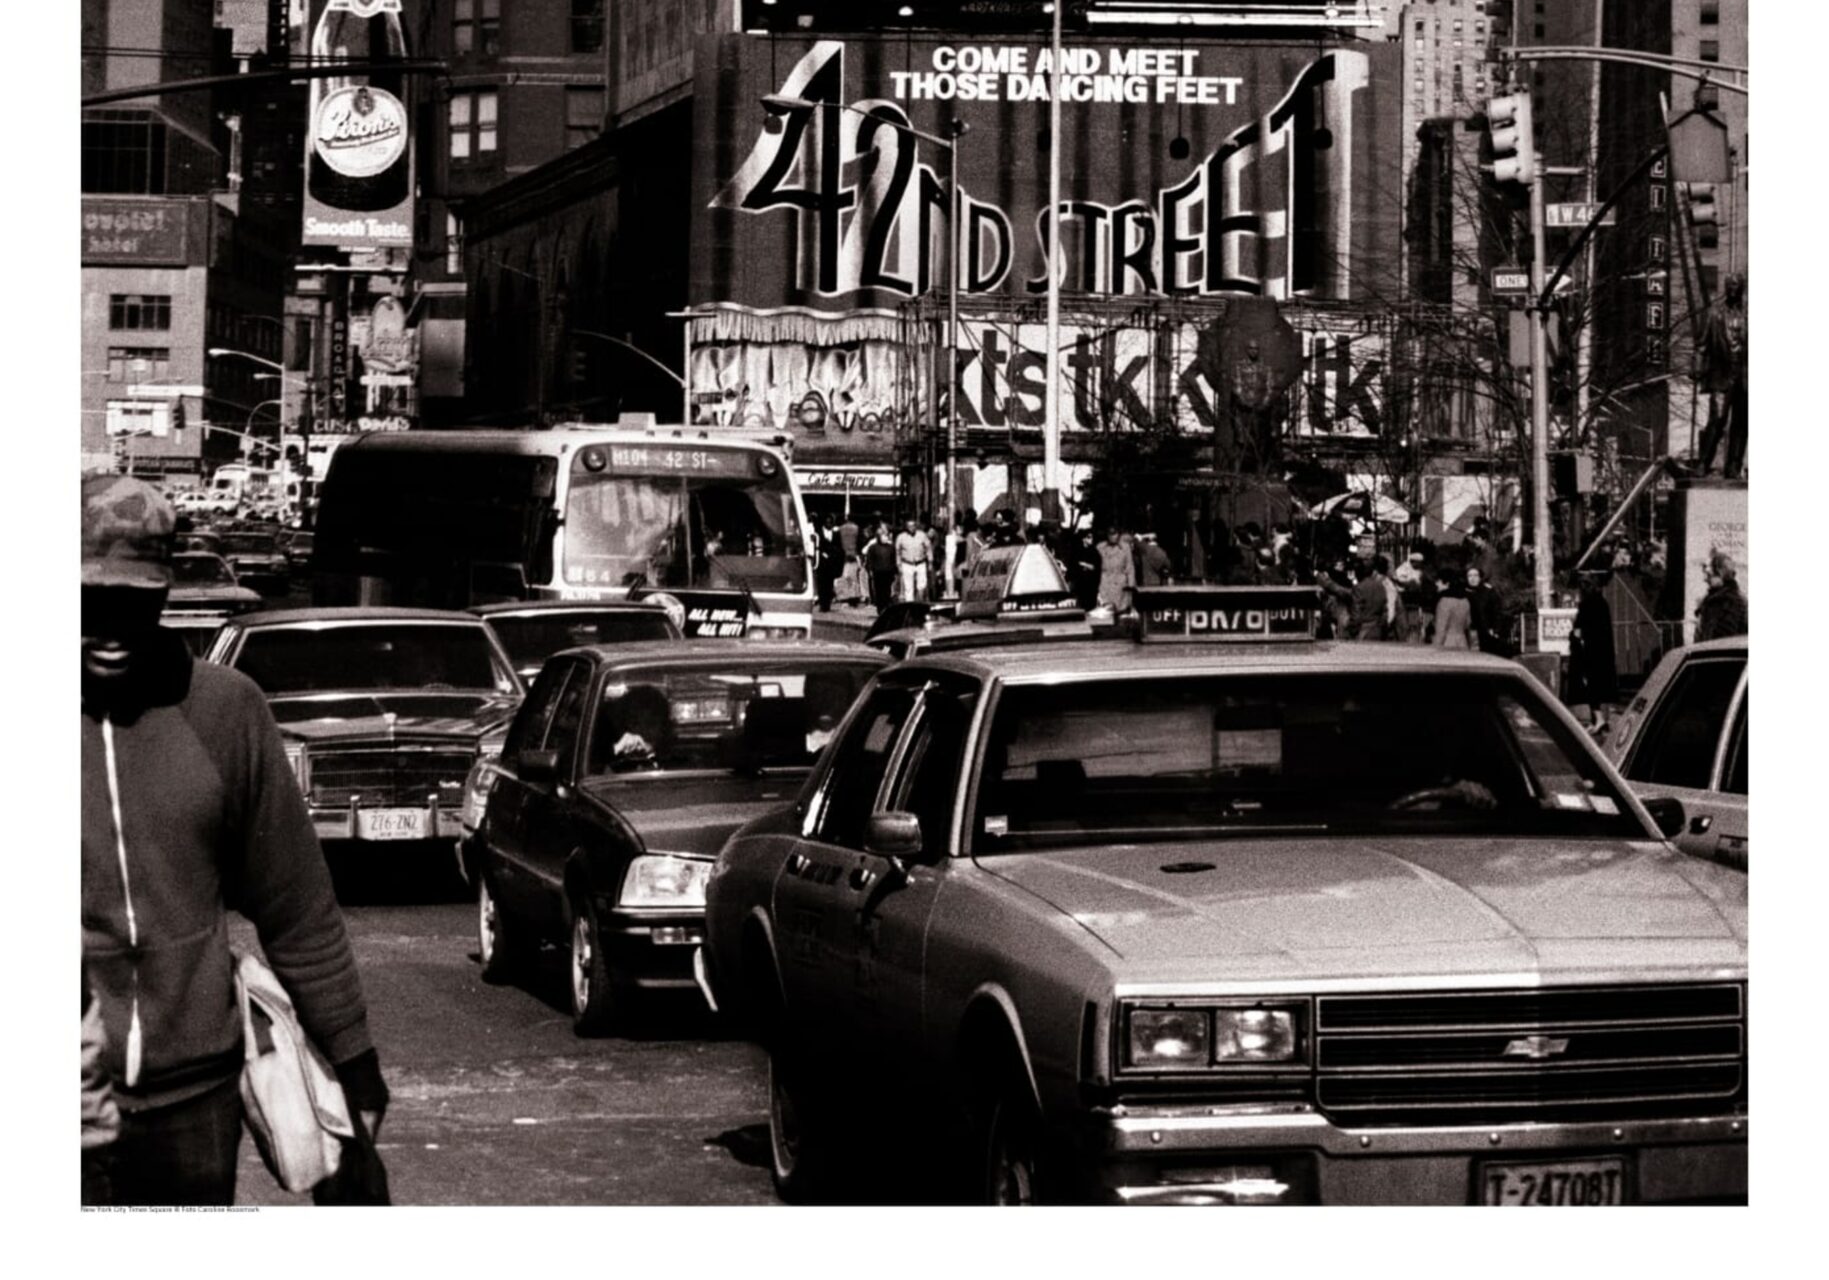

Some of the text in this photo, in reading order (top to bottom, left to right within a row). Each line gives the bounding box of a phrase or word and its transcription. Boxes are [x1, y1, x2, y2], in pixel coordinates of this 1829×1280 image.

[932, 46, 1200, 76] COME AND MEET
[889, 71, 1243, 104] THOSE DANCING FEET
[1026, 50, 1368, 300] STREET
[305, 217, 365, 235] Smooth
[1501, 275, 1526, 287] ONE
[665, 450, 684, 468] 42
